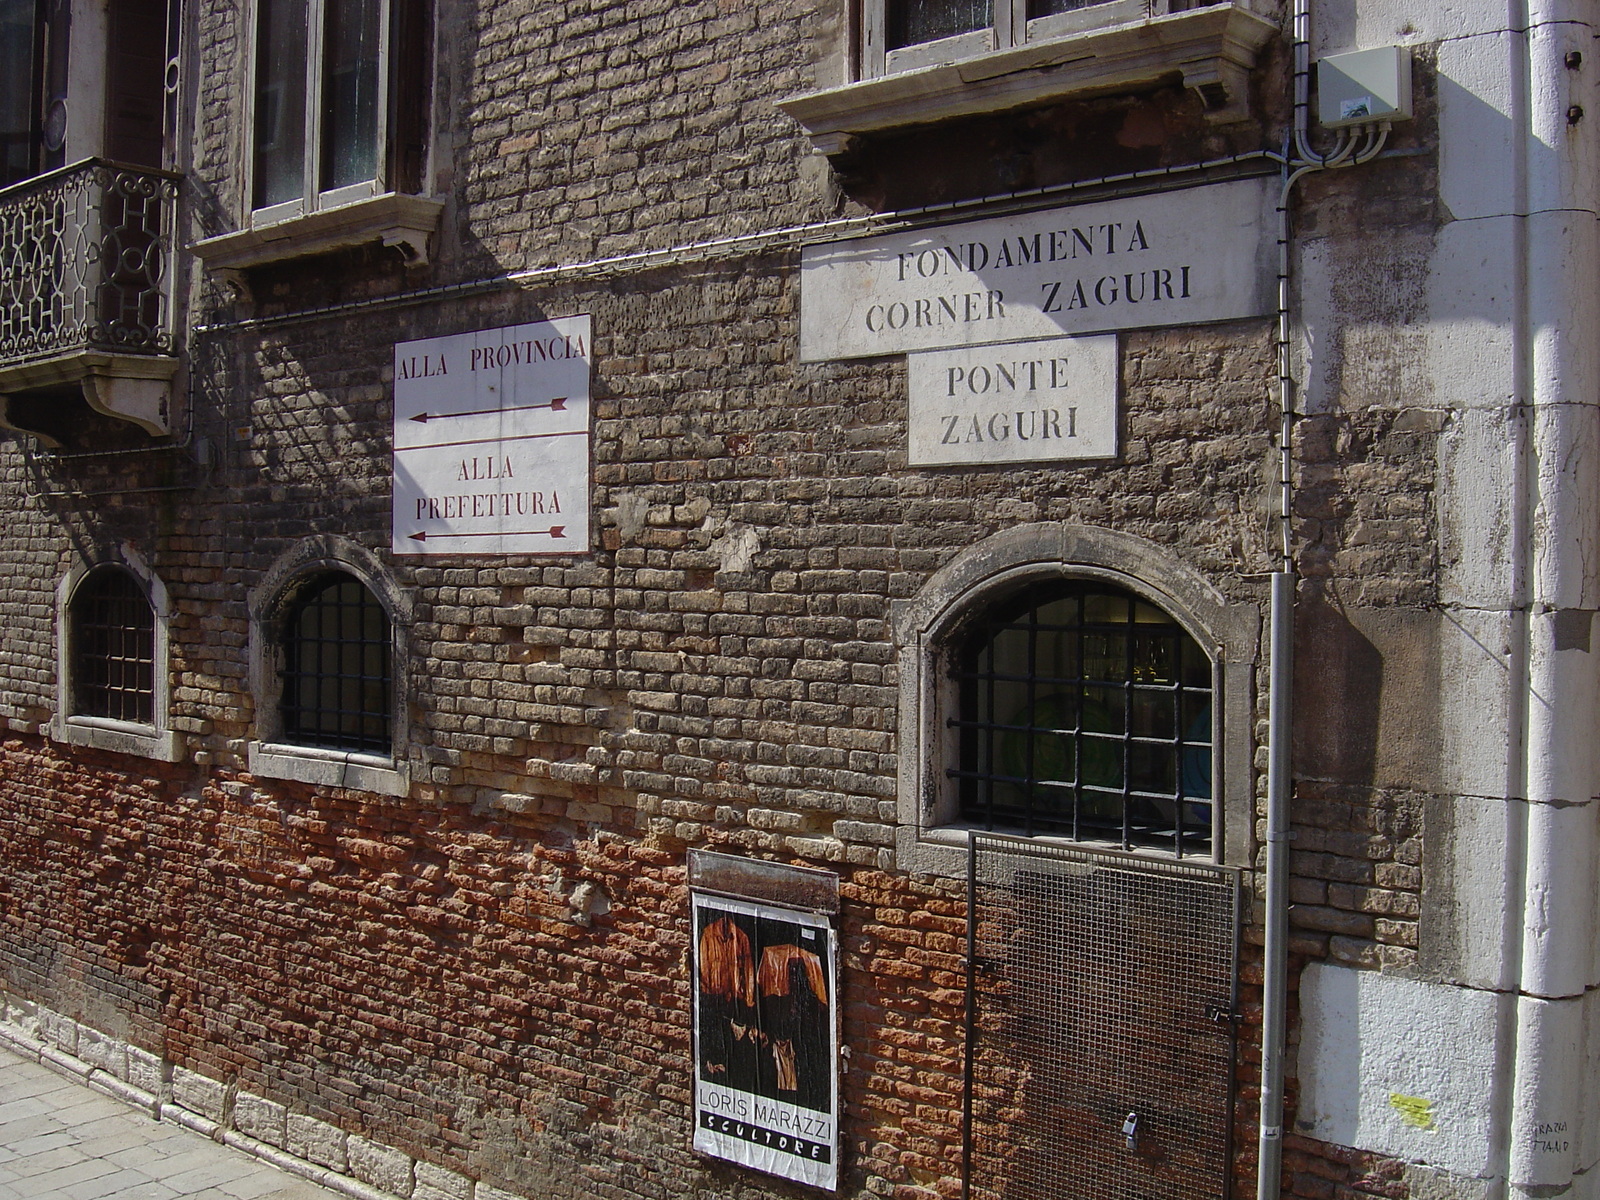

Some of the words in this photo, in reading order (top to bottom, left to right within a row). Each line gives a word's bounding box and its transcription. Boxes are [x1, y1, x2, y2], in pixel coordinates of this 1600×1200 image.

[897, 219, 1149, 281] FONDAMENTA
[866, 289, 1006, 333] CORNER
[1041, 266, 1192, 313] ZAGURI
[398, 353, 448, 380] ALLA
[470, 334, 587, 371] PROVINCIA
[947, 358, 1069, 396] PONTE
[941, 407, 1078, 445] ZAGURI
[457, 455, 514, 481] ALLA
[416, 490, 562, 520] PREFETTURA
[700, 1089, 747, 1116] LORIS
[754, 1103, 831, 1140] MARAZZI
[707, 1116, 819, 1158] SCULTORE
